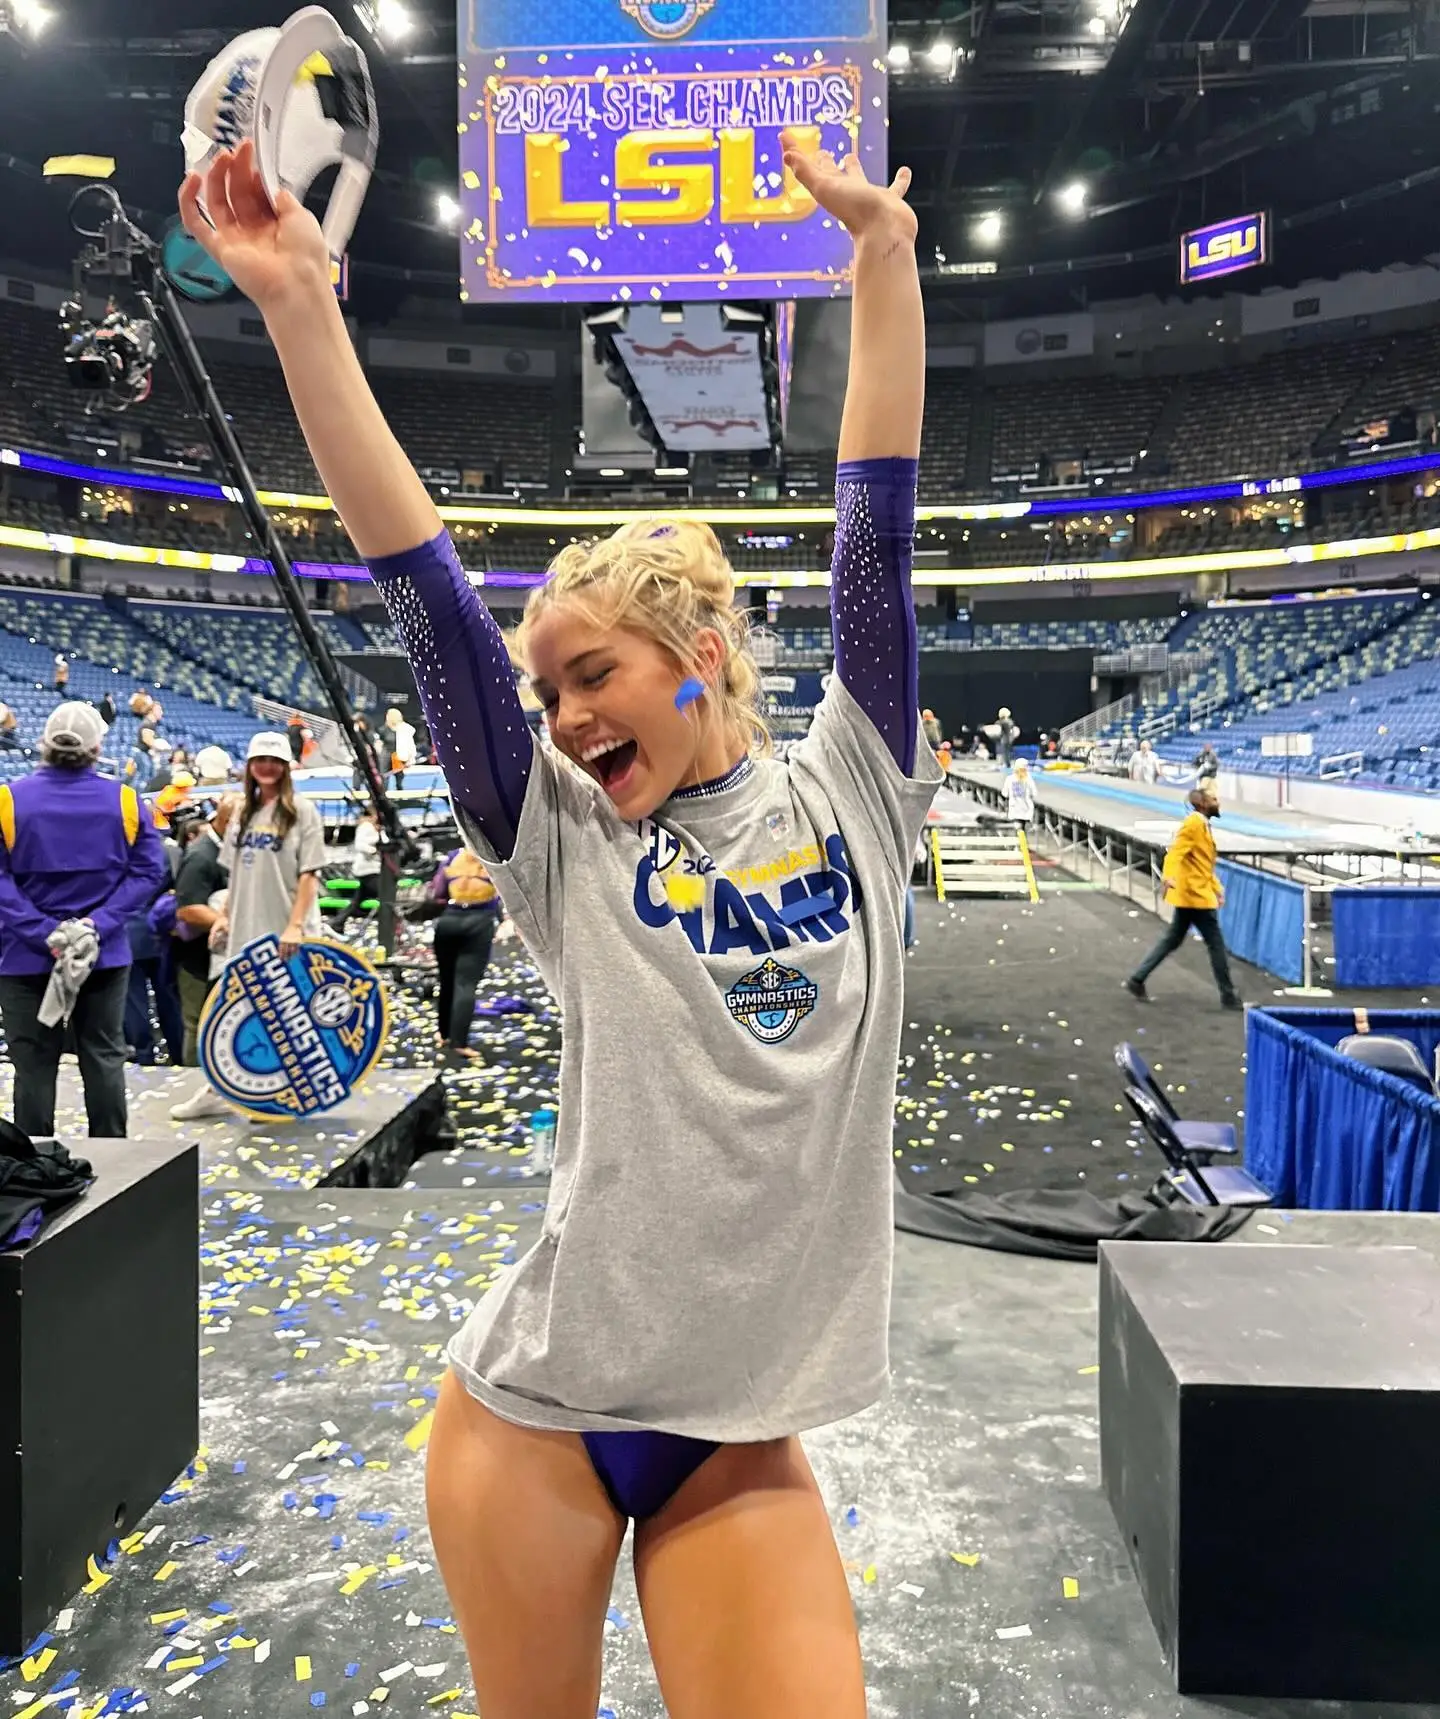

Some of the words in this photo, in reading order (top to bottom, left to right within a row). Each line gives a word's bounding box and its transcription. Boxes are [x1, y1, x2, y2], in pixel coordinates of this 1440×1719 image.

[496, 83, 591, 134] 2024
[602, 82, 675, 131] SEC
[686, 75, 847, 128] CHAMPS
[525, 125, 822, 228] LSU
[1188, 226, 1257, 269] LSU
[768, 703, 816, 716] REGION
[726, 986, 816, 1008] GYMNASTICS
[762, 972, 780, 990] SEC
[250, 939, 346, 1106] GYMNASTICS
[314, 986, 351, 1023] SEC
[731, 1000, 813, 1015] CHAMPIONSHIPS
[238, 959, 319, 1109] CHAMPIONSHIPS
